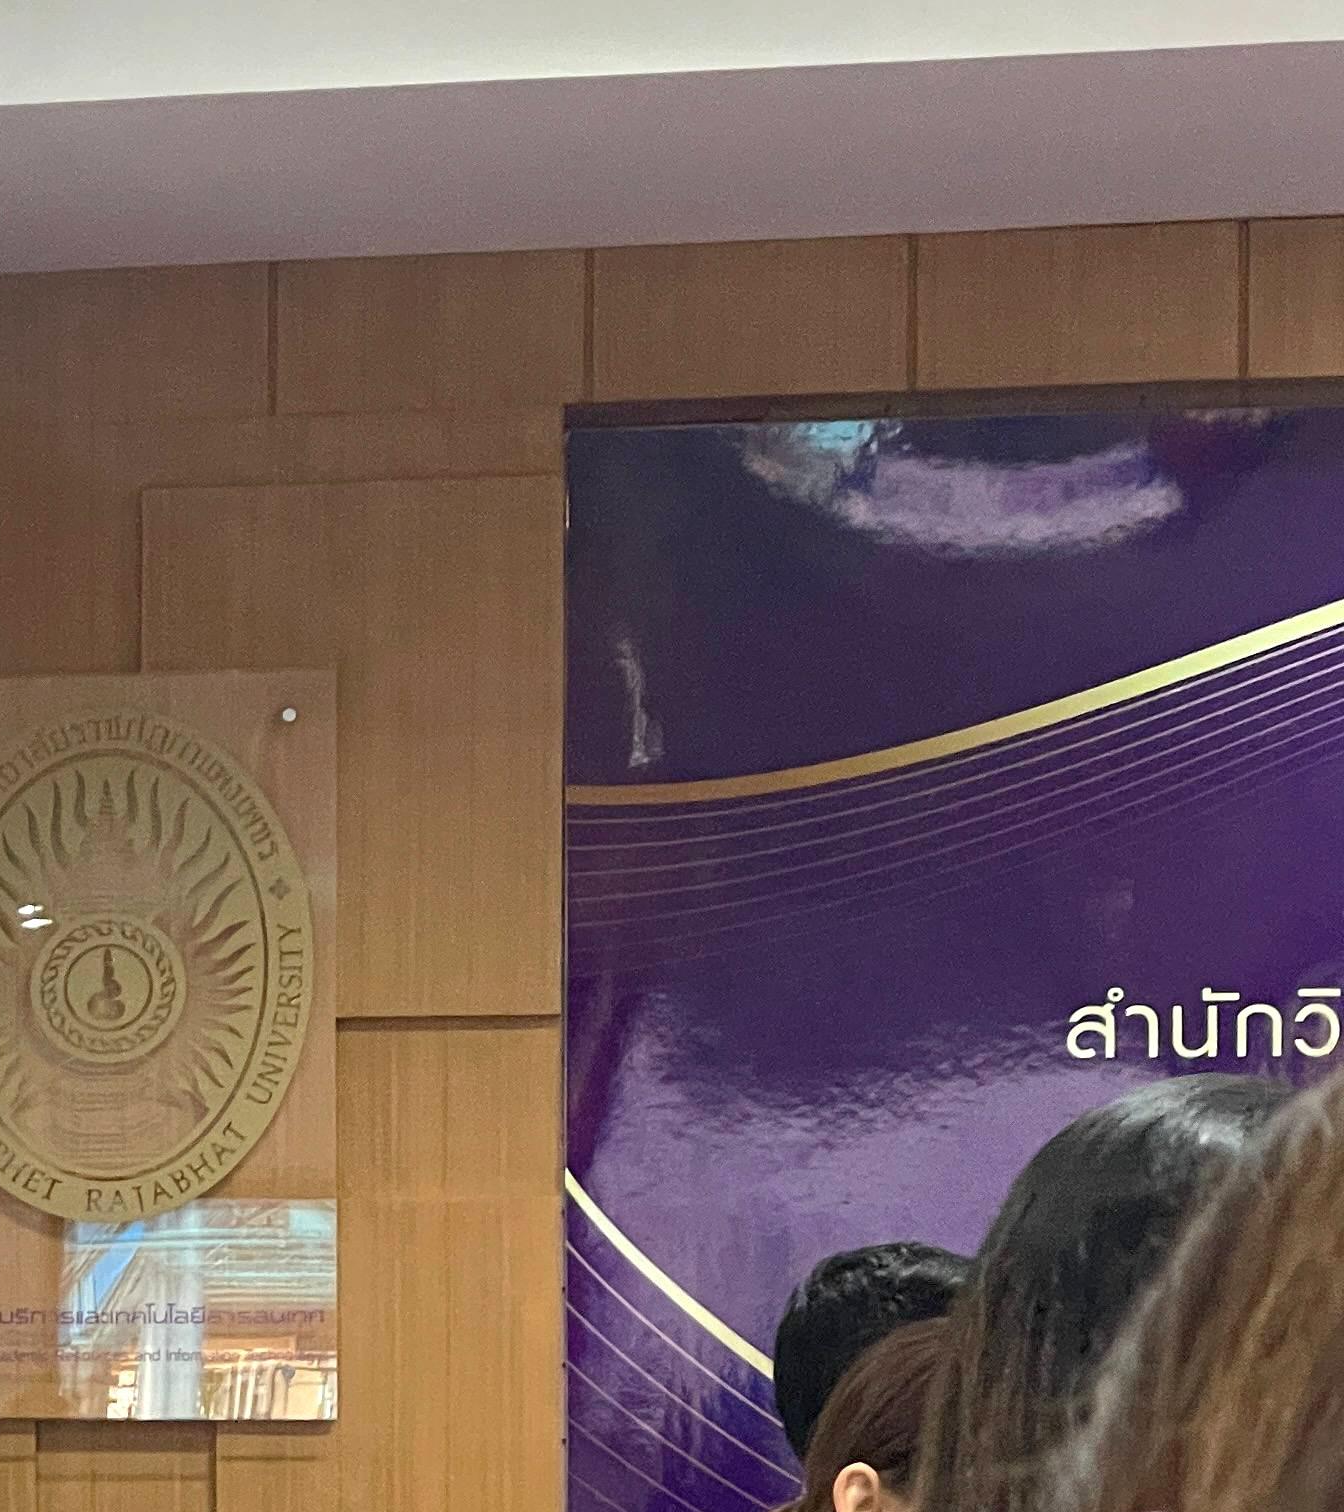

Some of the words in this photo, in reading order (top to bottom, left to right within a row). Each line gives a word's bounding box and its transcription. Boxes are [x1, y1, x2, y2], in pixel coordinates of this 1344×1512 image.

[84, 1120, 248, 1213] RAJABHAT
[245, 922, 304, 1105] UNIVERSITY
[136, 1347, 161, 1362] and
